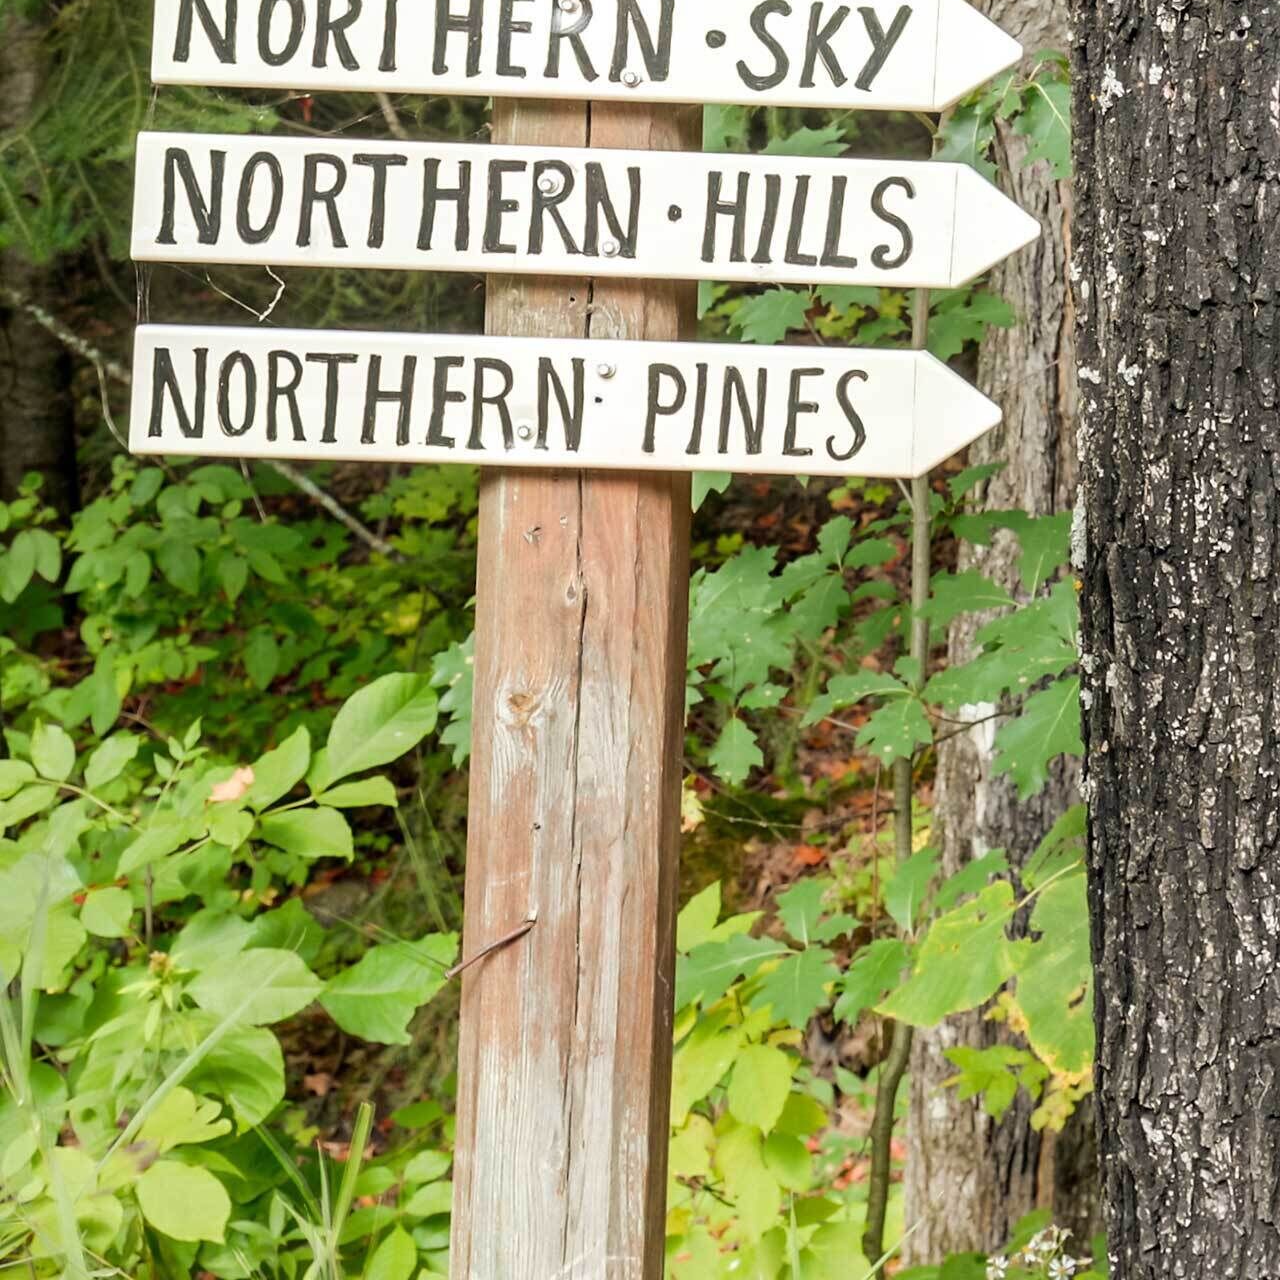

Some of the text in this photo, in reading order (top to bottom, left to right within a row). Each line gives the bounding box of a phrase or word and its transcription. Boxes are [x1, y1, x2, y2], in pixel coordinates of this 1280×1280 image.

[154, 147, 915, 270] NORTHERN HILLS
[147, 346, 869, 461] NORTHERN PINES
